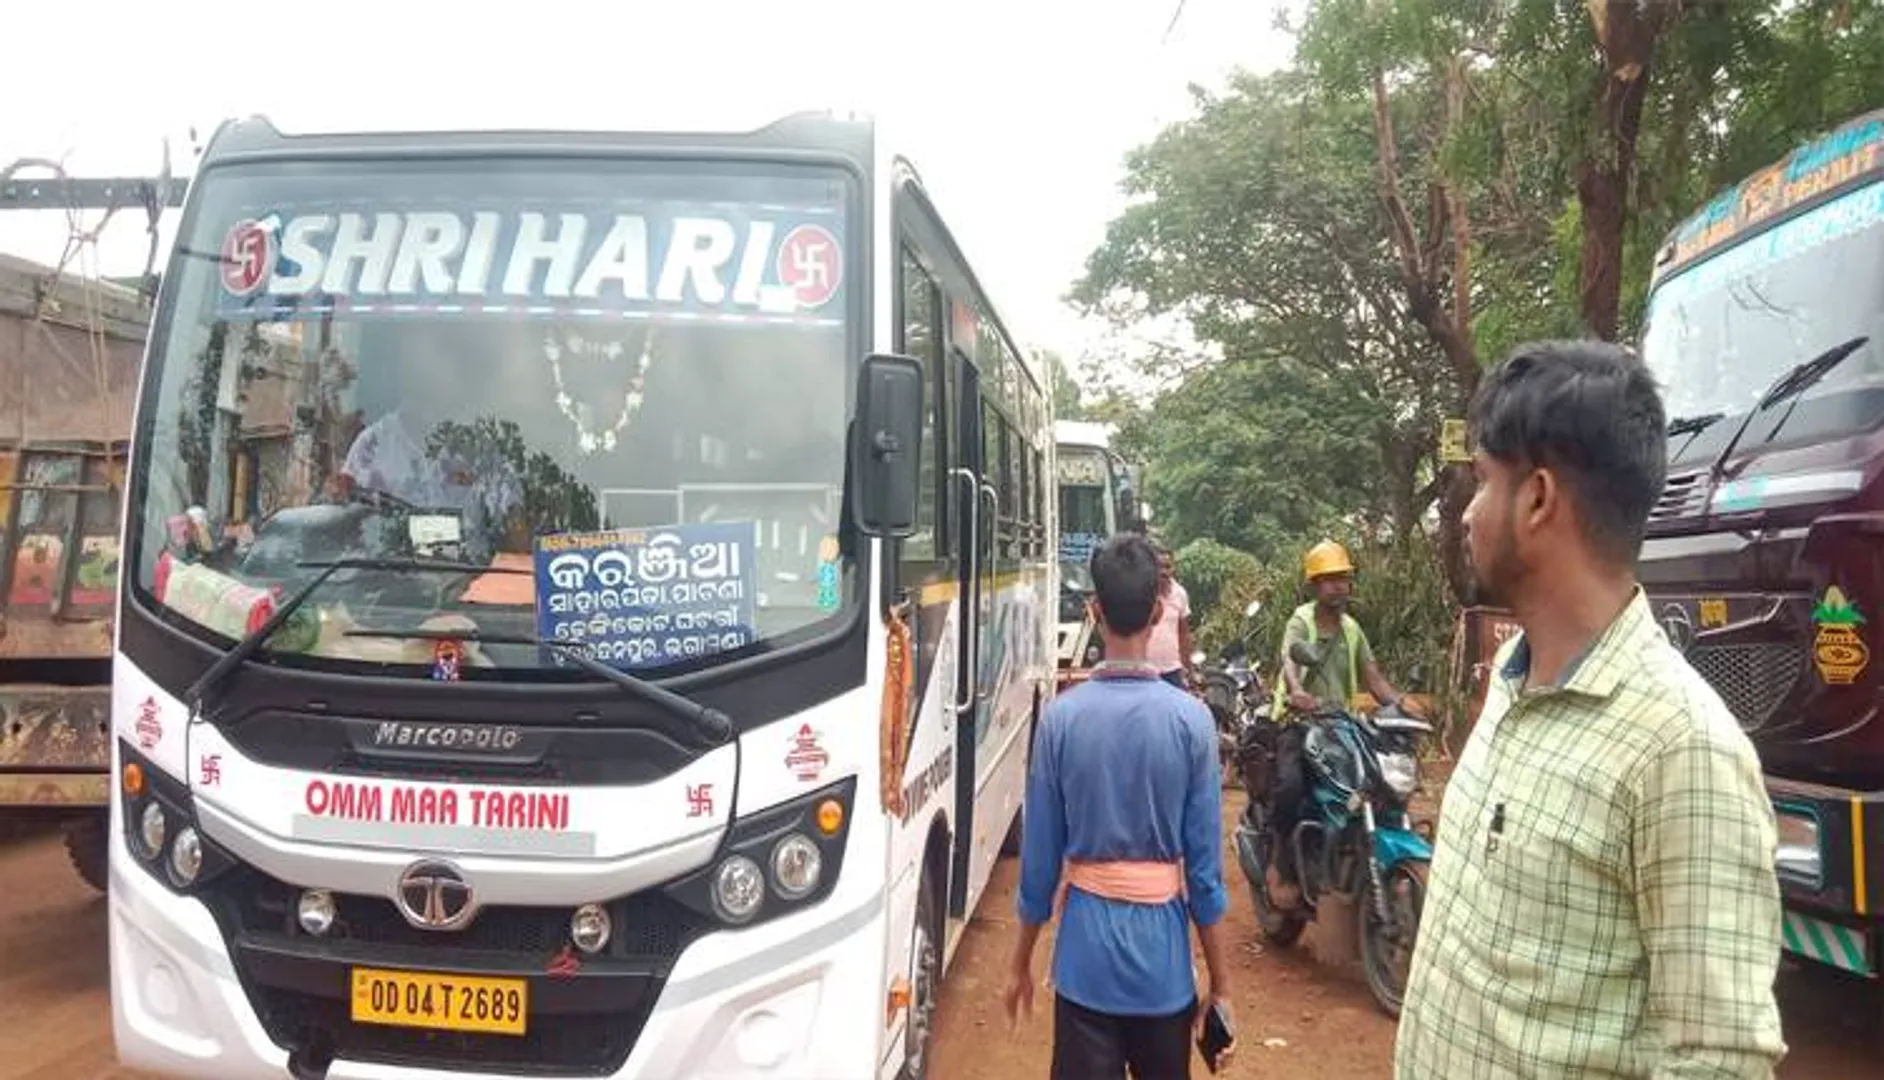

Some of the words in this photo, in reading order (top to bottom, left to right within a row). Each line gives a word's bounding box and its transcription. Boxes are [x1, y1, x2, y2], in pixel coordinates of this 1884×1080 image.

[268, 211, 499, 296] SHRI
[503, 211, 776, 306] HARI
[548, 533, 741, 590] କରଞ୍ଜିଆ
[375, 720, 522, 749] Marcopolo
[305, 780, 382, 823] OMM
[389, 787, 458, 826] MAA
[468, 790, 570, 830] TARINI
[460, 986, 520, 1023] 2689
